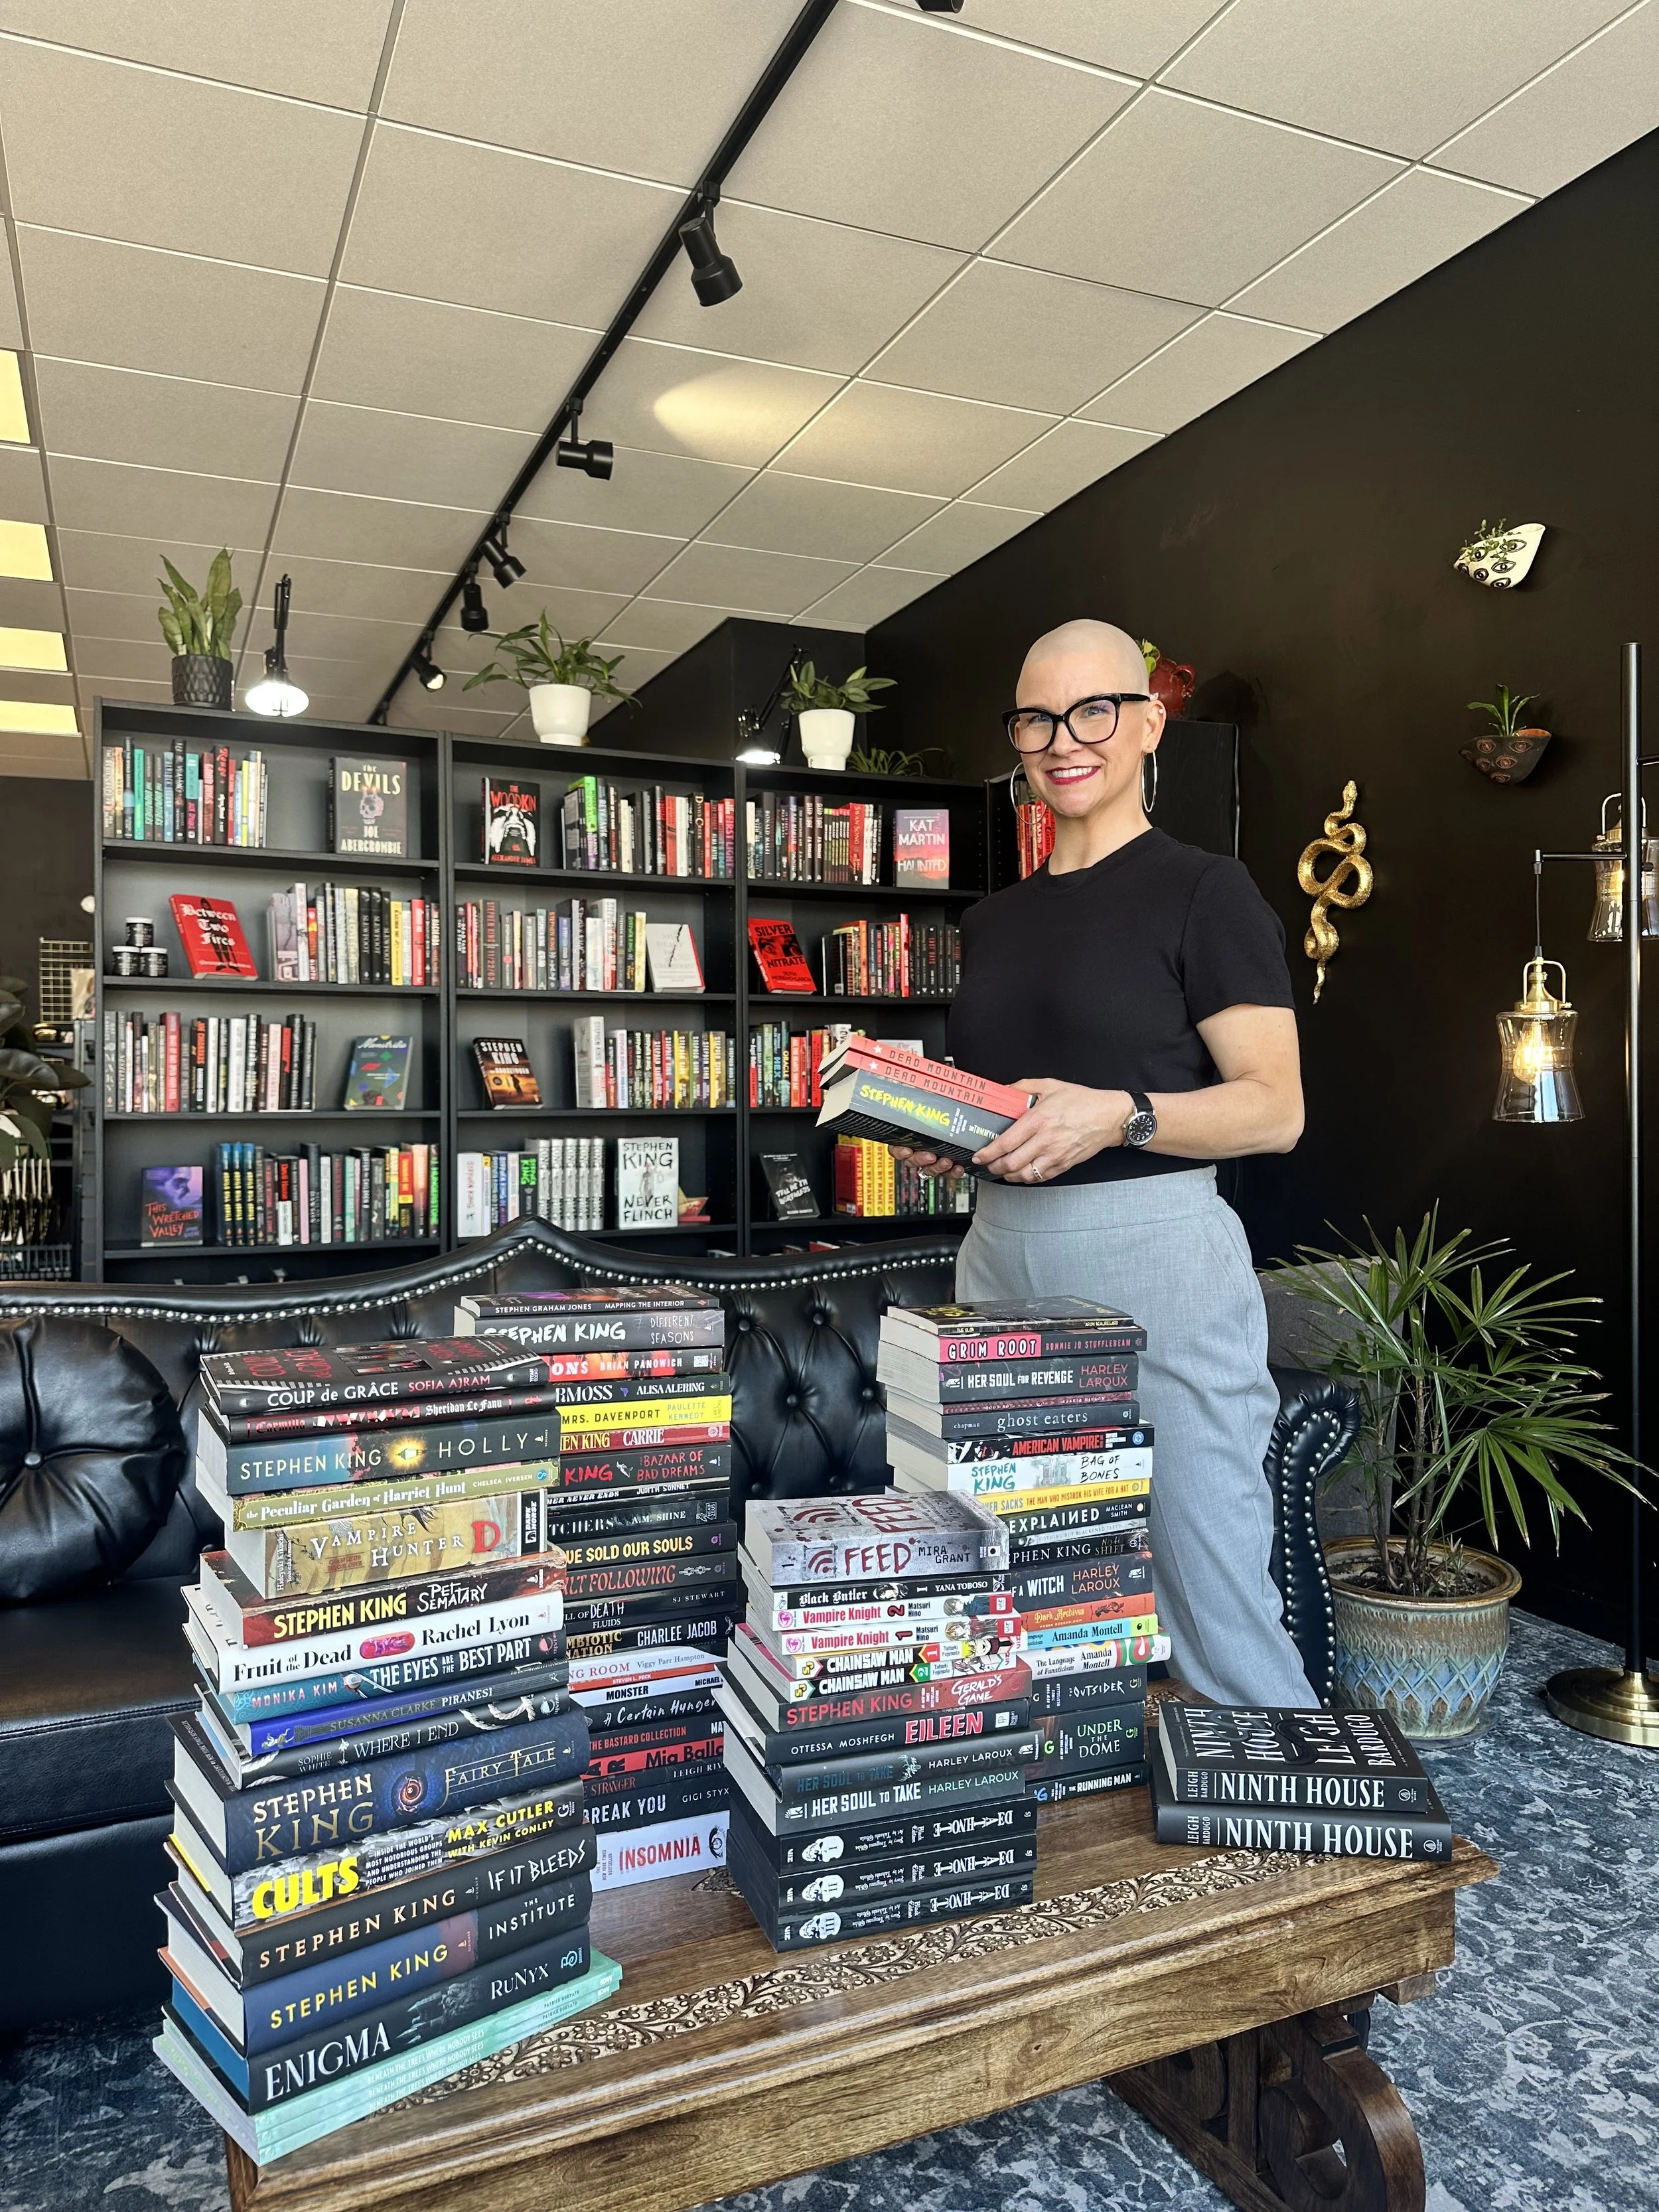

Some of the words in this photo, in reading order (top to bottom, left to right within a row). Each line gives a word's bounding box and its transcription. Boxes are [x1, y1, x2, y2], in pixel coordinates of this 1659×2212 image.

[342, 771, 401, 795] DEVILS
[490, 792, 536, 810] WOODKIN
[909, 819, 933, 832] KAT
[899, 833, 946, 846] MARTIN
[897, 859, 947, 872] HAUNTED
[755, 923, 791, 937] SILVER
[766, 956, 806, 968] NITRATE
[481, 1042, 523, 1053] STEPHEN
[492, 1053, 520, 1065] KING
[890, 1050, 919, 1067] DEAD
[928, 1065, 986, 1090] MOUNTAIN
[885, 1067, 916, 1082] DEAD
[924, 1079, 983, 1104] MOUNTAIN
[860, 1086, 914, 1114] STEPHEN
[916, 1104, 950, 1126] KING
[623, 1142, 673, 1152] STEPHEN
[623, 1153, 673, 1169] KING
[146, 1203, 167, 1216] THIS
[624, 1195, 671, 1208] NEVER
[152, 1211, 199, 1225] WRETCHED
[624, 1209, 673, 1222] FLINCH
[149, 1224, 184, 1238] VALLEY
[495, 1304, 530, 1313] STEPHEN
[650, 1313, 695, 1328] DIFFERENT
[650, 1331, 693, 1344] SEASONS
[1045, 1341, 1070, 1351] BONNIE
[1084, 1338, 1130, 1349] STUFFLEBEAM
[948, 1340, 987, 1359] GRIM
[999, 1338, 1036, 1357] ROOT
[601, 1360, 629, 1370] BRIAN
[634, 1358, 682, 1368] PANOWICH
[1080, 1363, 1127, 1375] HARLEY
[408, 1379, 444, 1392] SOFIA
[447, 1374, 490, 1388] AJRAM
[968, 1374, 987, 1388] HER
[989, 1372, 1015, 1387] SOUL
[1031, 1370, 1073, 1385] REVENGE
[1078, 1376, 1127, 1388] LAROUX
[267, 1392, 315, 1408] COUP
[321, 1389, 338, 1402] de
[343, 1382, 399, 1399] GRÂCE
[562, 1414, 589, 1425] MRS.
[595, 1409, 660, 1422] DAVENPORT
[997, 1414, 1039, 1432] ghost
[1045, 1411, 1088, 1424] eaters
[438, 1433, 528, 1458] HOLLY
[622, 1430, 665, 1446] CARRIE
[240, 1460, 326, 1480] STEPHEN
[335, 1450, 382, 1469] KING
[1080, 1456, 1104, 1469] BAG
[1108, 1455, 1120, 1465] OF
[472, 1477, 502, 1487] CHELSEA
[505, 1473, 533, 1483] IVERSEN
[1080, 1469, 1119, 1483] BONES
[246, 1509, 258, 1520] the
[260, 1500, 318, 1520] Peculiar
[321, 1493, 369, 1512] Garden
[373, 1493, 382, 1503] of
[383, 1487, 430, 1504] Harriet
[435, 1481, 467, 1497] Hunt
[587, 1544, 619, 1562] SOLD
[622, 1541, 650, 1557] OUR
[653, 1536, 693, 1554] SOULS
[845, 1543, 911, 1574] FEED
[918, 1546, 948, 1556] MIRA
[935, 1552, 970, 1563] GRANT
[935, 1583, 958, 1591] YANA
[959, 1581, 987, 1589] TOBOSO
[1027, 1575, 1064, 1597] WITCH
[273, 1601, 357, 1639] STEPHEN
[360, 1592, 407, 1623] KING
[803, 1609, 846, 1624] Vampire
[848, 1605, 881, 1621] Knight
[421, 1624, 481, 1645] Rachel
[488, 1615, 530, 1637] Lyon
[637, 1625, 682, 1647] CHARLEE
[685, 1620, 717, 1639] JACOB
[1052, 1629, 1089, 1642] Amanda
[1092, 1623, 1123, 1637] Montell
[285, 1661, 300, 1670] the
[287, 1654, 297, 1663] of
[303, 1647, 352, 1668] Dead
[370, 1666, 399, 1689] THE
[403, 1660, 439, 1682] EYES
[459, 1646, 492, 1670] BEST
[496, 1638, 531, 1661] PART
[827, 1652, 886, 1673] CHAINSAW
[889, 1649, 913, 1664] MAN
[234, 1660, 284, 1682] Fruit
[606, 1685, 649, 1700] MONSTER
[952, 1675, 1002, 1694] GERALD'S
[1074, 1680, 1125, 1698] OUTSIDER
[252, 1690, 305, 1709] MONIKA
[312, 1682, 337, 1694] KIM
[441, 1686, 493, 1707] PIRANESI
[958, 1690, 993, 1706] GAME
[786, 1700, 866, 1725] STEPHEN
[869, 1694, 912, 1712] KING
[905, 1712, 983, 1743] EILEEN
[1077, 1720, 1123, 1737] UNDER
[604, 1734, 638, 1749] BASTARD
[640, 1726, 686, 1743] COLLECTION
[791, 1742, 833, 1755] OTTESSA
[839, 1733, 895, 1747] MOSHFEGH
[1079, 1739, 1120, 1757] DOME
[1188, 1771, 1198, 1799] LEIGH
[1221, 1772, 1297, 1803] NINTH
[1306, 1777, 1384, 1808] HOUSE
[682, 1793, 703, 1803] GIGI
[706, 1787, 729, 1799] STYX
[812, 1798, 838, 1817] HER
[841, 1792, 876, 1813] SOUL
[879, 1792, 890, 1803] TO
[893, 1783, 922, 1801] TAKE
[447, 1822, 486, 1844] MAX
[496, 1800, 554, 1828] CUTLER
[1188, 1815, 1198, 1844] LEIGH
[447, 1843, 475, 1859] WITH
[478, 1832, 509, 1850] KEVIN
[512, 1820, 554, 1838] CONLEY
[1225, 1817, 1313, 1851] NINTH
[1323, 1823, 1413, 1858] HOUSE
[618, 1836, 701, 1871] INSOMNIA
[366, 1874, 386, 1885] PEOPLE
[389, 1870, 403, 1879] WHO
[405, 1864, 425, 1874] JOINED
[427, 1858, 443, 1867] THEM
[488, 1871, 504, 1891] IF
[508, 1864, 525, 1885] IT
[528, 1839, 586, 1880] BLEEDS
[252, 1857, 360, 1919] CULTS
[488, 1893, 575, 1939] INSTITUTE
[259, 1914, 381, 1968] STEPHEN
[394, 1889, 457, 1924] KING
[264, 2023, 390, 2101] ENIGMA
